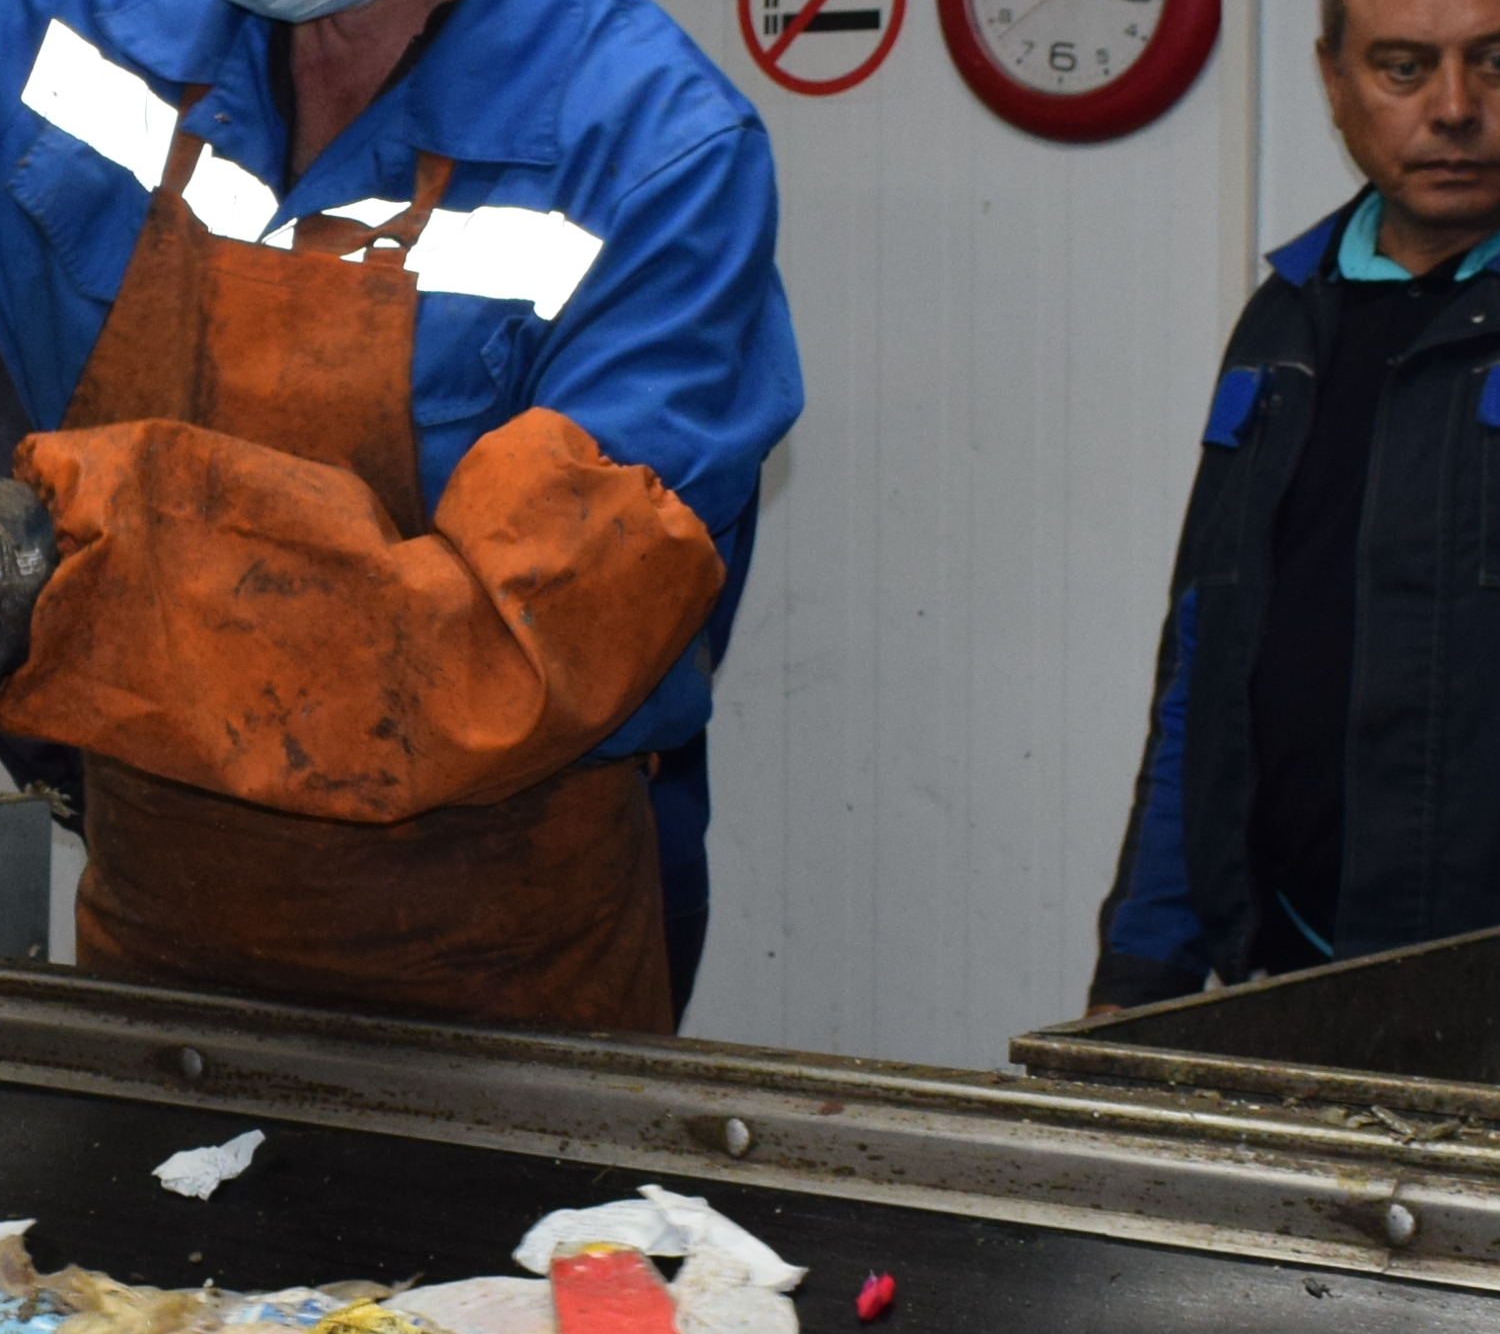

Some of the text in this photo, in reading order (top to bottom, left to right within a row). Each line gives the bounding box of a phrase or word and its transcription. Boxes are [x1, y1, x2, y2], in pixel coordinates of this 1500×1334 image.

[998, 8, 1013, 25] 8
[1124, 23, 1139, 38] 4
[1021, 39, 1036, 55] 7
[1049, 41, 1078, 72] 6
[1097, 48, 1111, 66] 5
